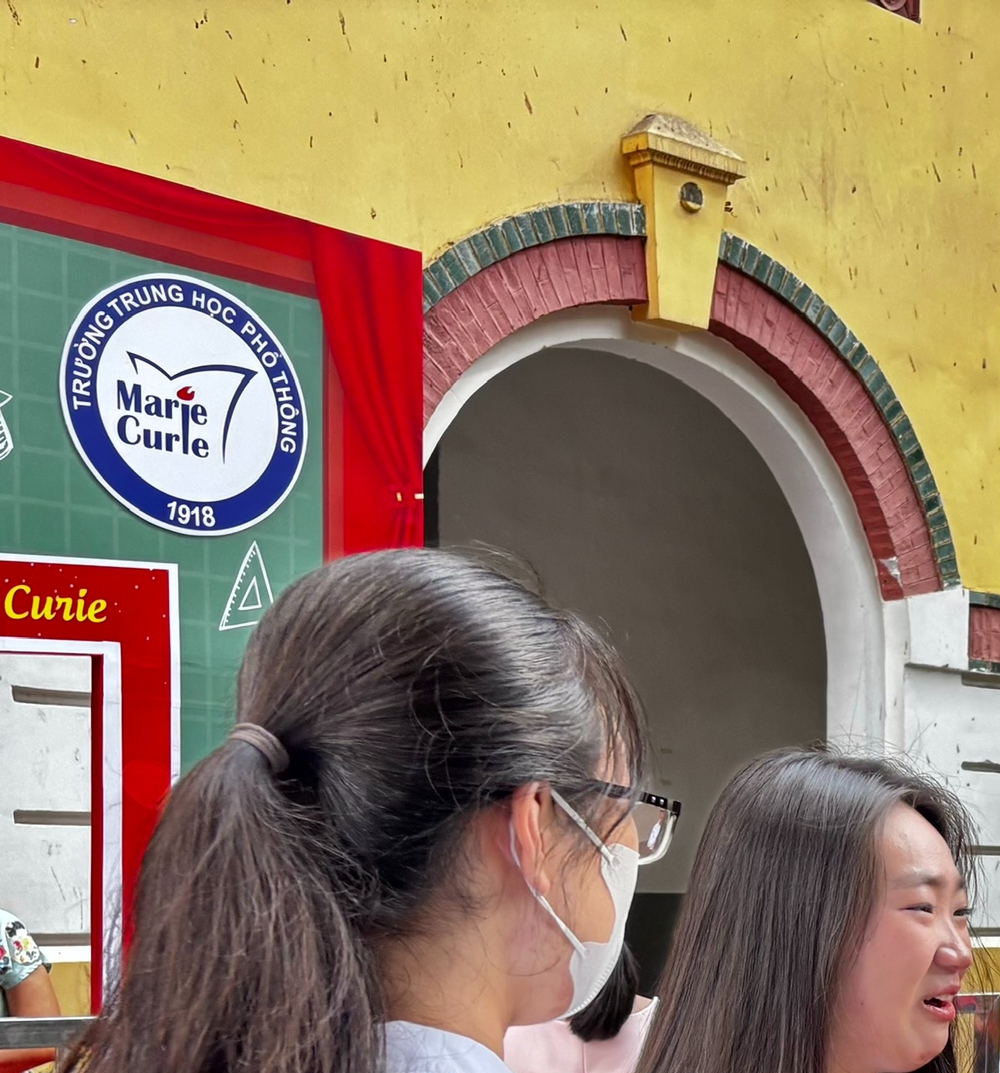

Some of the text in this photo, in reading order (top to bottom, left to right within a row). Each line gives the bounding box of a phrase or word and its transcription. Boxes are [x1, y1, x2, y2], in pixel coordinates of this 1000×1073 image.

[72, 311, 114, 410] TRƯỜNG
[107, 284, 184, 317] TRUNG
[192, 290, 237, 324] HỌC
[272, 371, 300, 454] THÔNG
[116, 380, 208, 425] Marie
[167, 501, 216, 527] 1918
[4, 584, 108, 623] Curie
